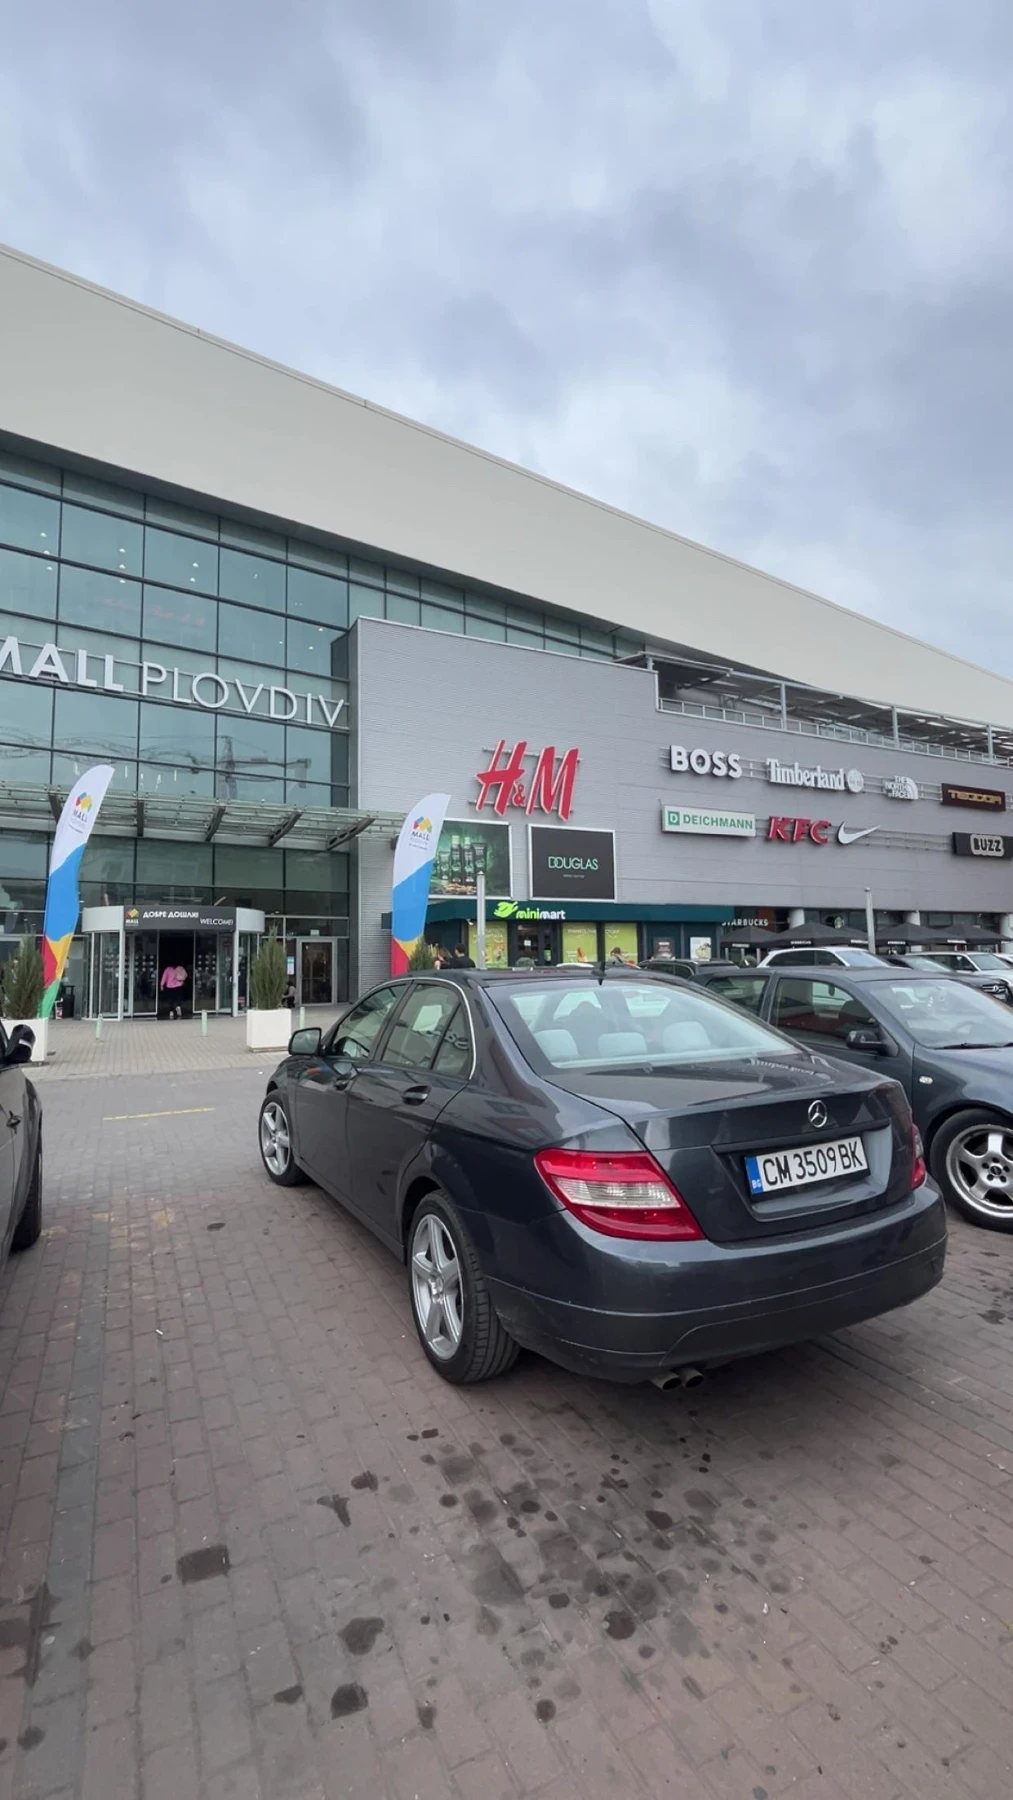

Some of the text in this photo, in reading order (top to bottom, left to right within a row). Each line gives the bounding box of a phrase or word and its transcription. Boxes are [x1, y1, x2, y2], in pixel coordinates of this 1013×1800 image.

[142, 661, 345, 727] PLOVDIV
[670, 744, 743, 779] BOSS
[475, 739, 579, 822] H&M
[766, 757, 846, 791] Timberland
[894, 775, 908, 783] THE
[892, 789, 909, 799] FACE
[683, 814, 753, 830] DEICHMANN
[768, 815, 831, 844] KFC
[973, 837, 1002, 853] BUZZ
[548, 855, 599, 871] DOUGLAS
[516, 907, 566, 920] minimart
[200, 918, 234, 926] WELCOME!
[751, 1179, 762, 1189] BG
